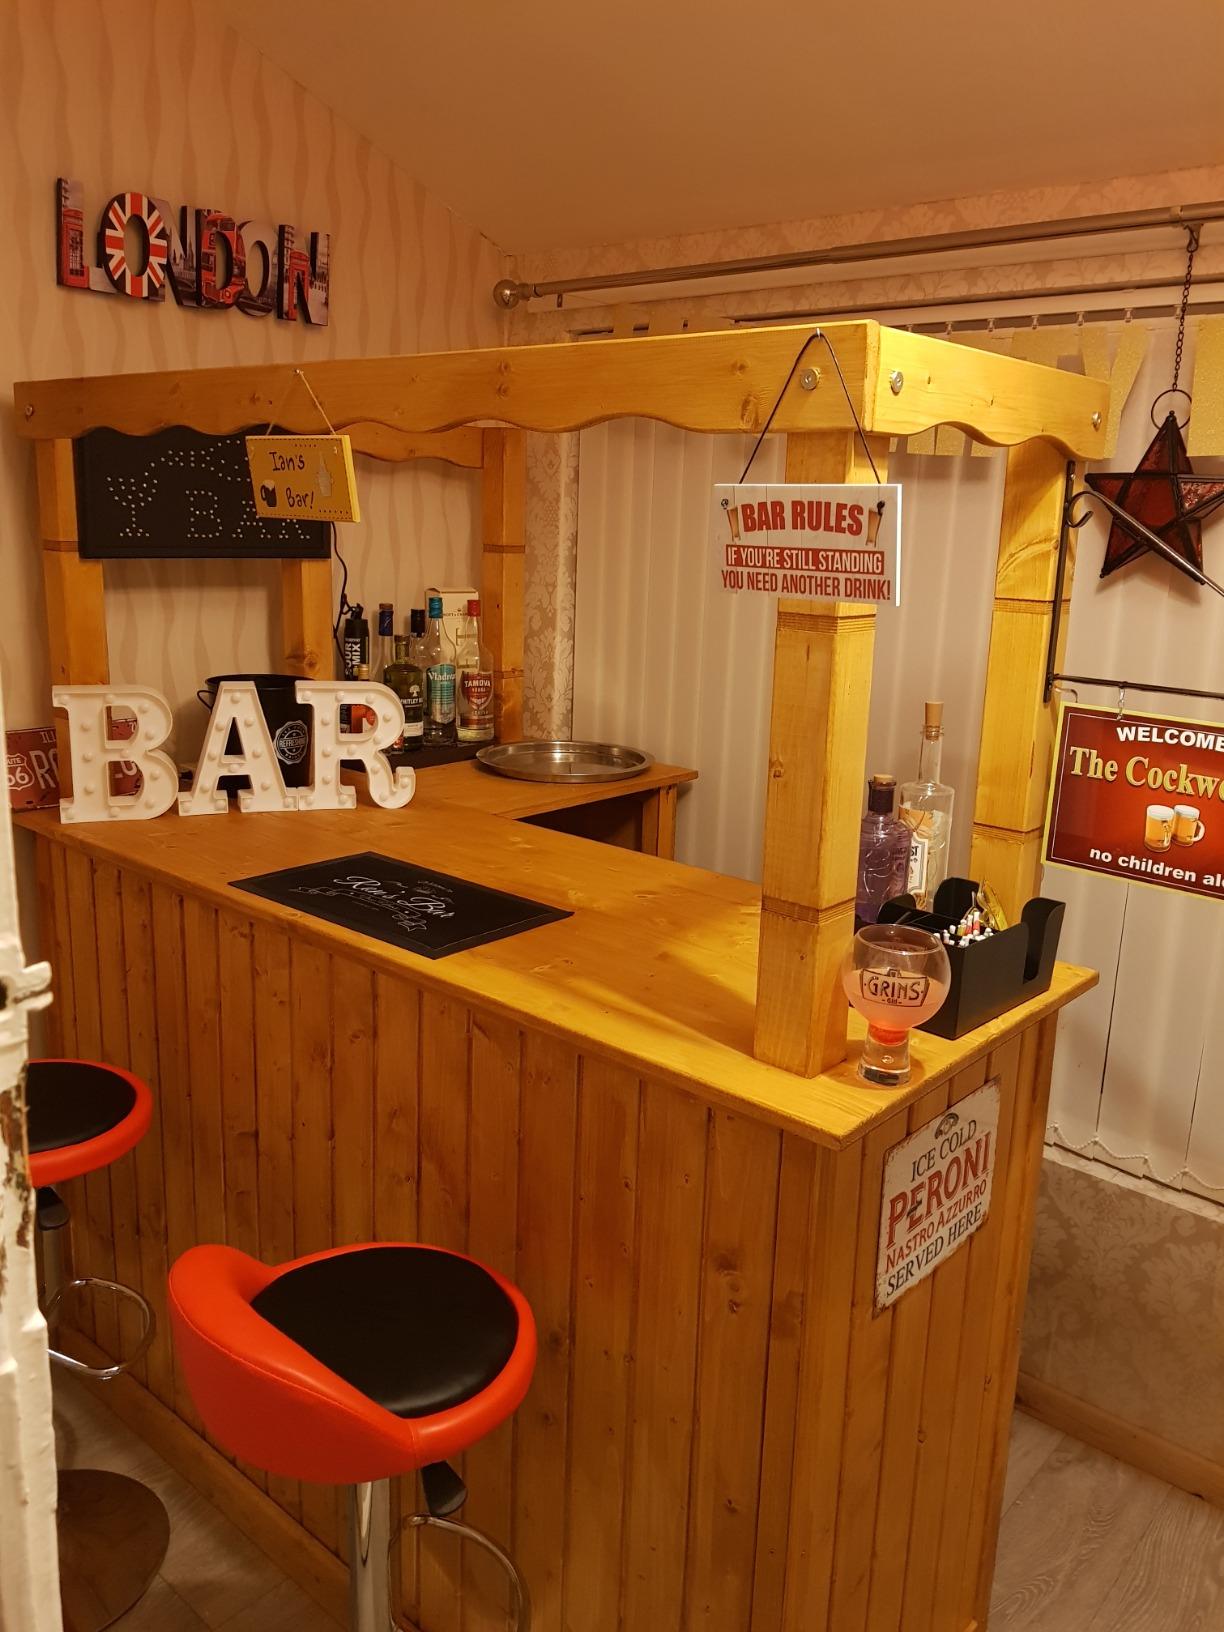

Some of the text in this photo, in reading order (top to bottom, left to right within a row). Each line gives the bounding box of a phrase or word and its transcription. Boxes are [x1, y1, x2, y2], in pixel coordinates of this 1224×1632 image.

[56, 176, 331, 326] LONDON
[269, 452, 305, 471] Ian's
[286, 487, 314, 509] Bar!
[741, 500, 864, 536] BAR RULES
[728, 546, 882, 574] IF YOU'RE STILL STANDING
[721, 570, 891, 600] YOU NEED ANOTHER DRINK!
[351, 643, 361, 665] MIX
[464, 679, 491, 688] TAMOVA
[51, 680, 416, 825] BAR
[1117, 726, 1224, 752] WELCOME
[1070, 746, 1118, 782] The
[1089, 848, 1112, 863] no
[1118, 856, 1197, 883] children
[398, 896, 455, 918] Bar
[868, 978, 920, 1001] GRINS
[910, 1119, 977, 1183] ICE COLD
[887, 1131, 992, 1249] PERONI
[885, 1178, 988, 1274] NASTRO AZZURRO
[886, 1201, 983, 1298] SERVED HERE
